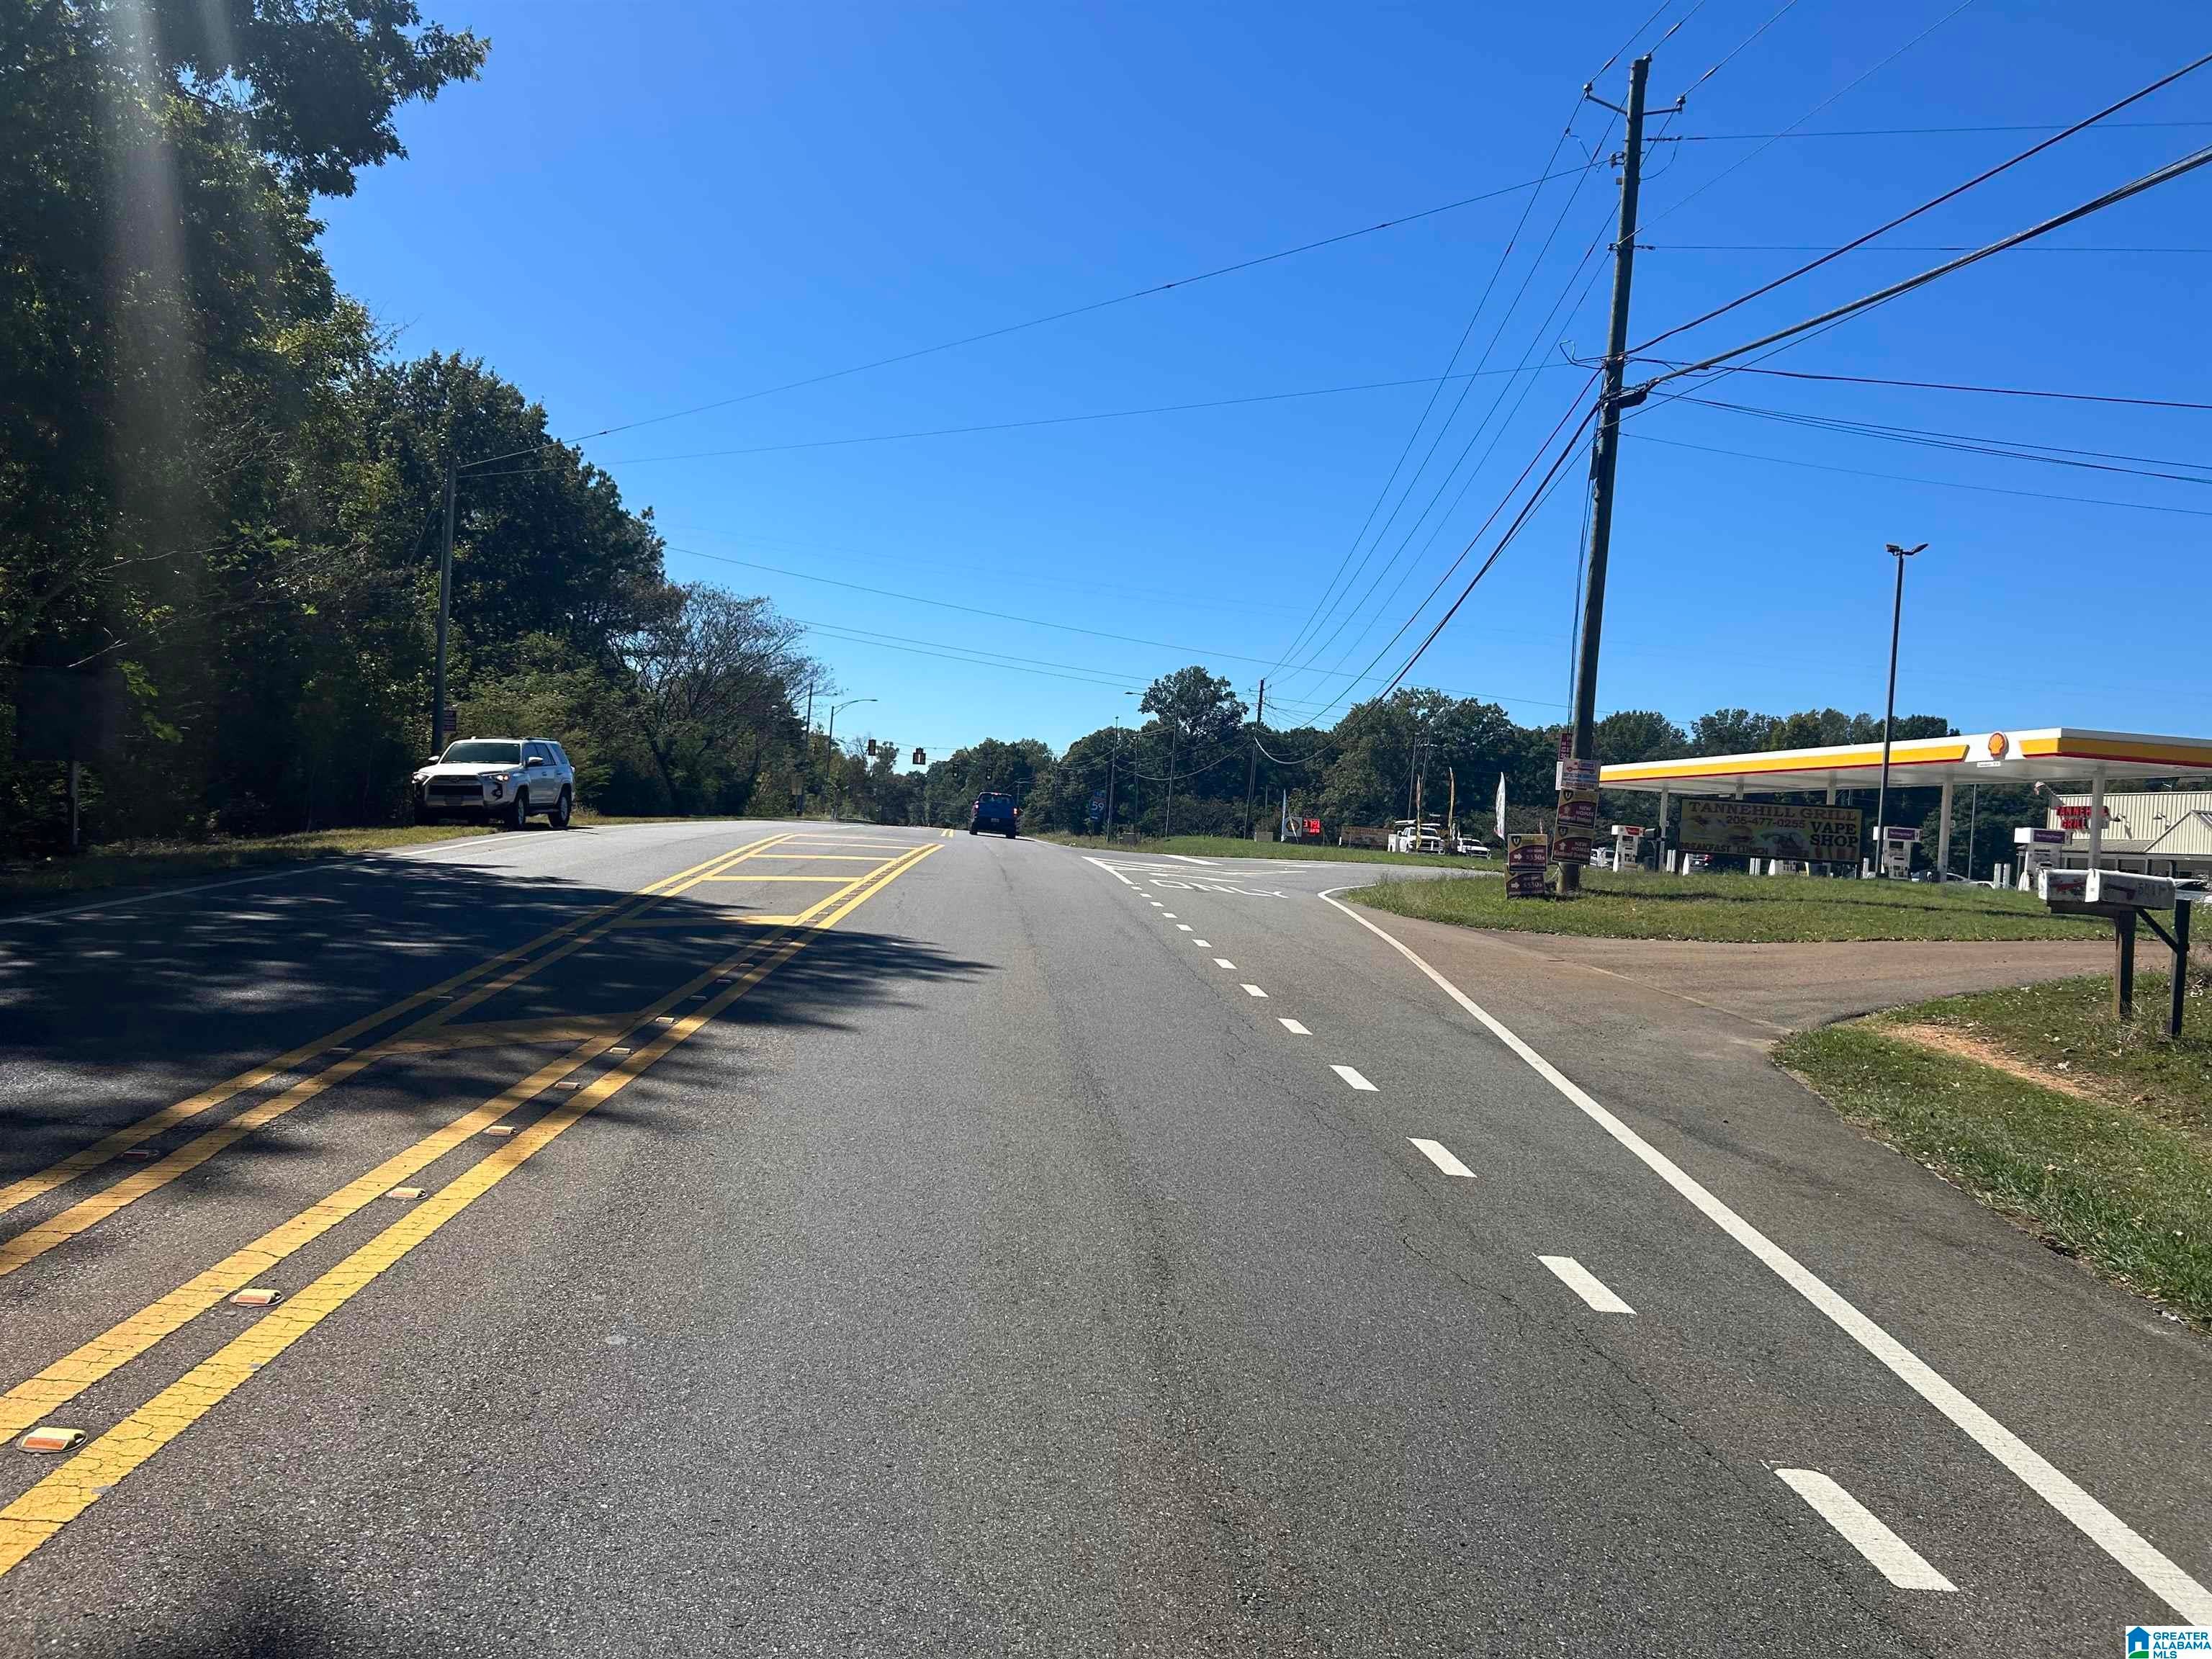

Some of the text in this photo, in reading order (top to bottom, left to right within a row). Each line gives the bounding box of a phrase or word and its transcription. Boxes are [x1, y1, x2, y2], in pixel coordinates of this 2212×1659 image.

[1090, 801, 1105, 811] 59
[1689, 801, 1858, 822] TANNEHILL GRILL
[1809, 821, 1857, 835] VAPE
[1809, 835, 1859, 848] SHOP
[1736, 845, 1769, 855] LUNCH
[1149, 879, 1289, 899] ONLY
